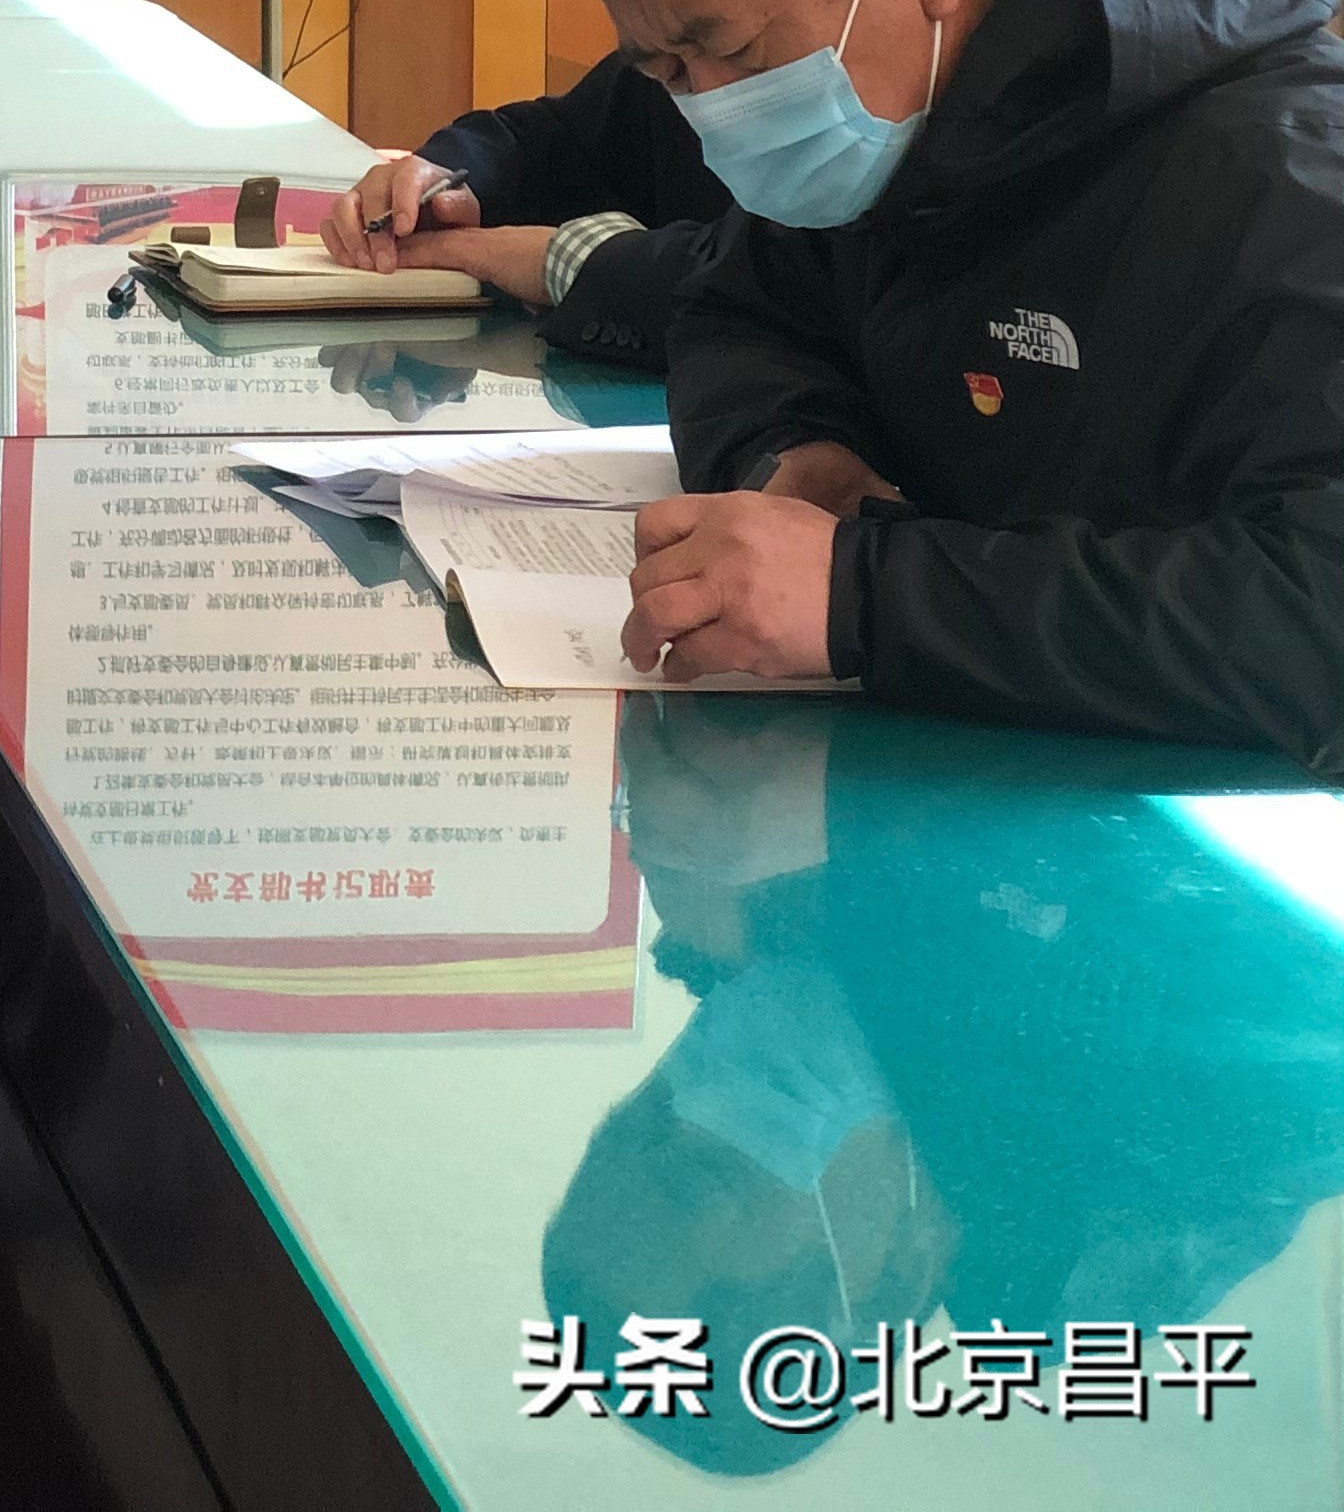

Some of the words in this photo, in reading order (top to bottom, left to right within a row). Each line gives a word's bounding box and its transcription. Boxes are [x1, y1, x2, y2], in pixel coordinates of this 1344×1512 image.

[1015, 308, 1050, 330] THE
[989, 321, 1052, 347] NORTH
[1008, 341, 1053, 364] FACE
